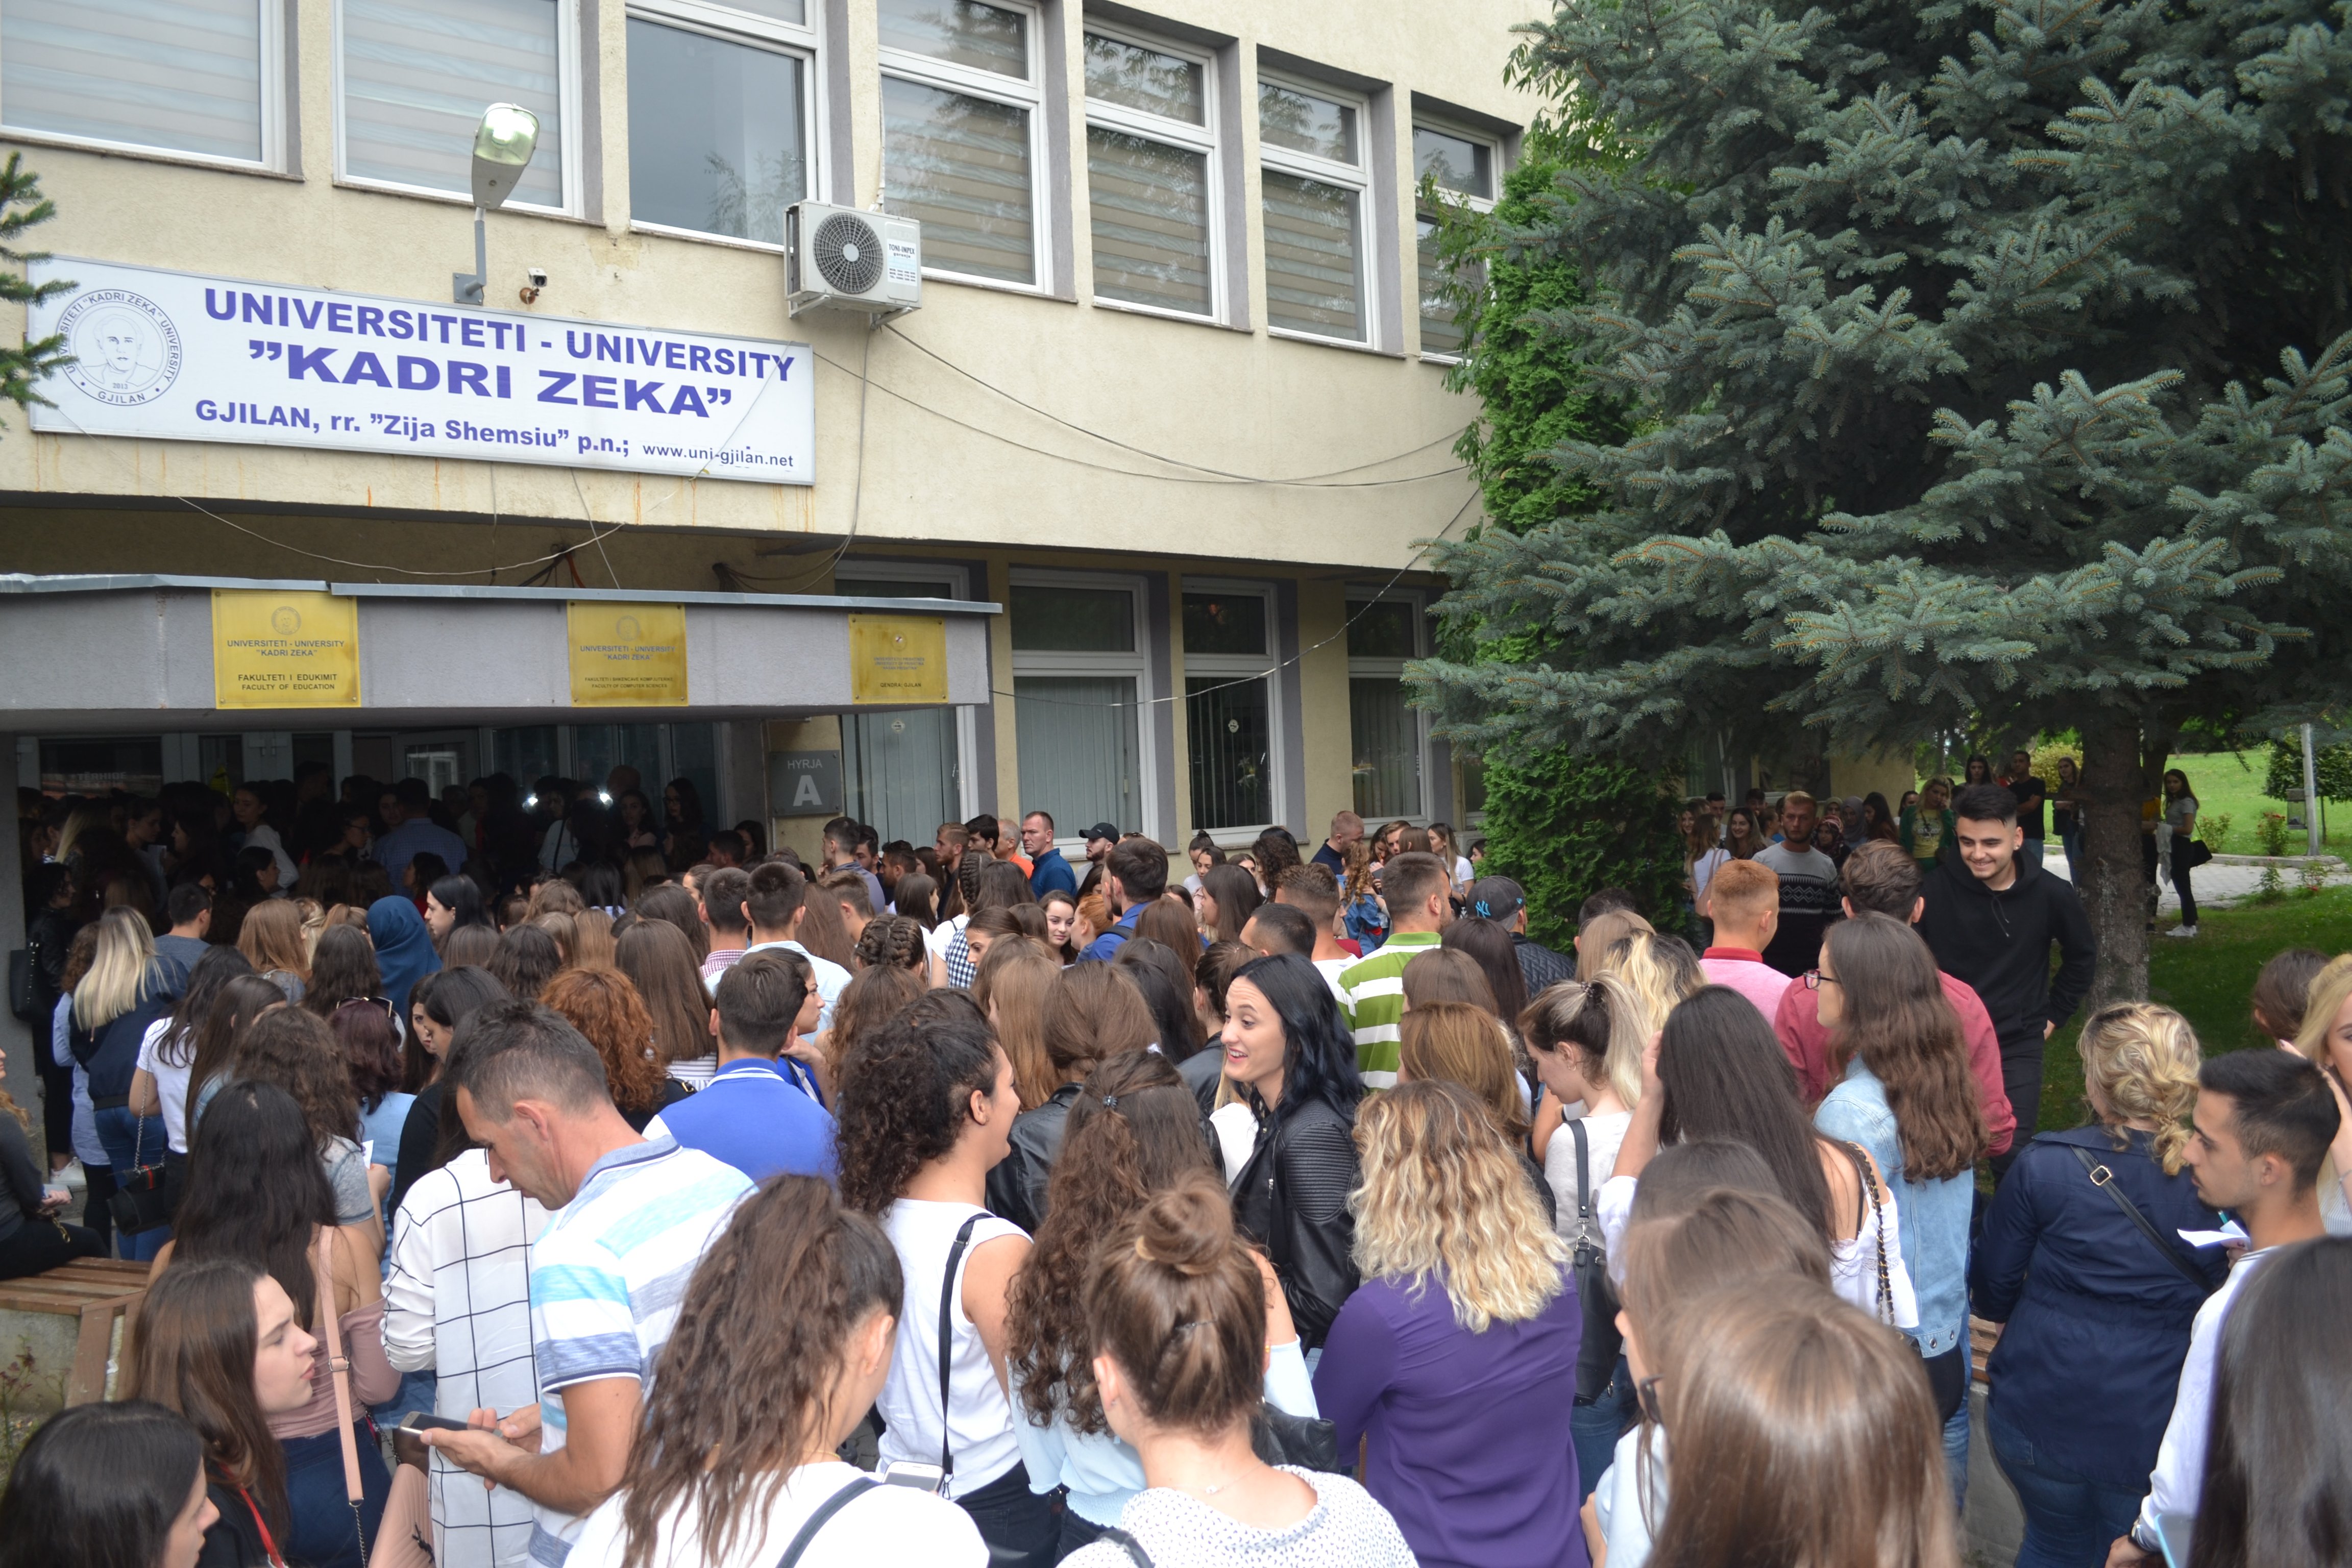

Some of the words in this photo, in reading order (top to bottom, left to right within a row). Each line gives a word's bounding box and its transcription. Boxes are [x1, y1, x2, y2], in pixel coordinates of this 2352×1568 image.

[889, 243, 915, 254] TONI-IMPEX
[206, 289, 525, 352] UNIVERSITETI
[567, 331, 794, 381] UNIVERSITY
[160, 320, 179, 383] UNIVERSITY
[98, 391, 146, 404] GJILAN
[197, 400, 319, 433] GJILAN,
[332, 416, 360, 432] rr.
[578, 436, 628, 456] p.n.;
[643, 445, 794, 467] www.uni-gjilan.net
[788, 759, 822, 769] HYRJA
[793, 775, 822, 806] A
